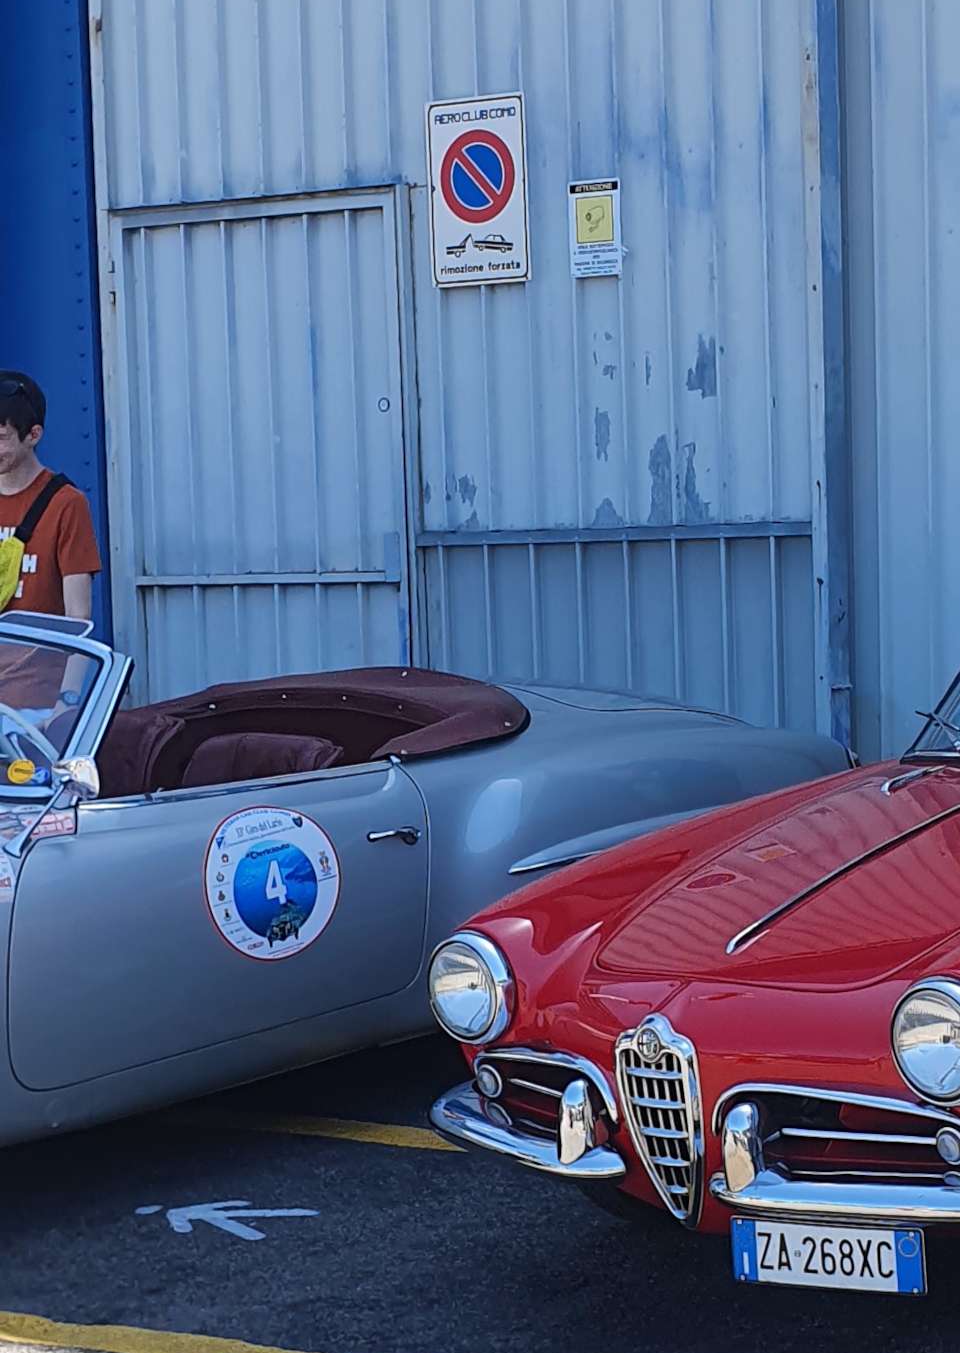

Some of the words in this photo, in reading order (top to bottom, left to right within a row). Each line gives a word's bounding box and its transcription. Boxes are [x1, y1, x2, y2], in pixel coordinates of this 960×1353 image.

[441, 264, 484, 275] rimozione
[488, 260, 521, 271] forzata
[266, 860, 287, 905] 4
[757, 1232, 792, 1271] ZA
[802, 1236, 894, 1279] 268XC
